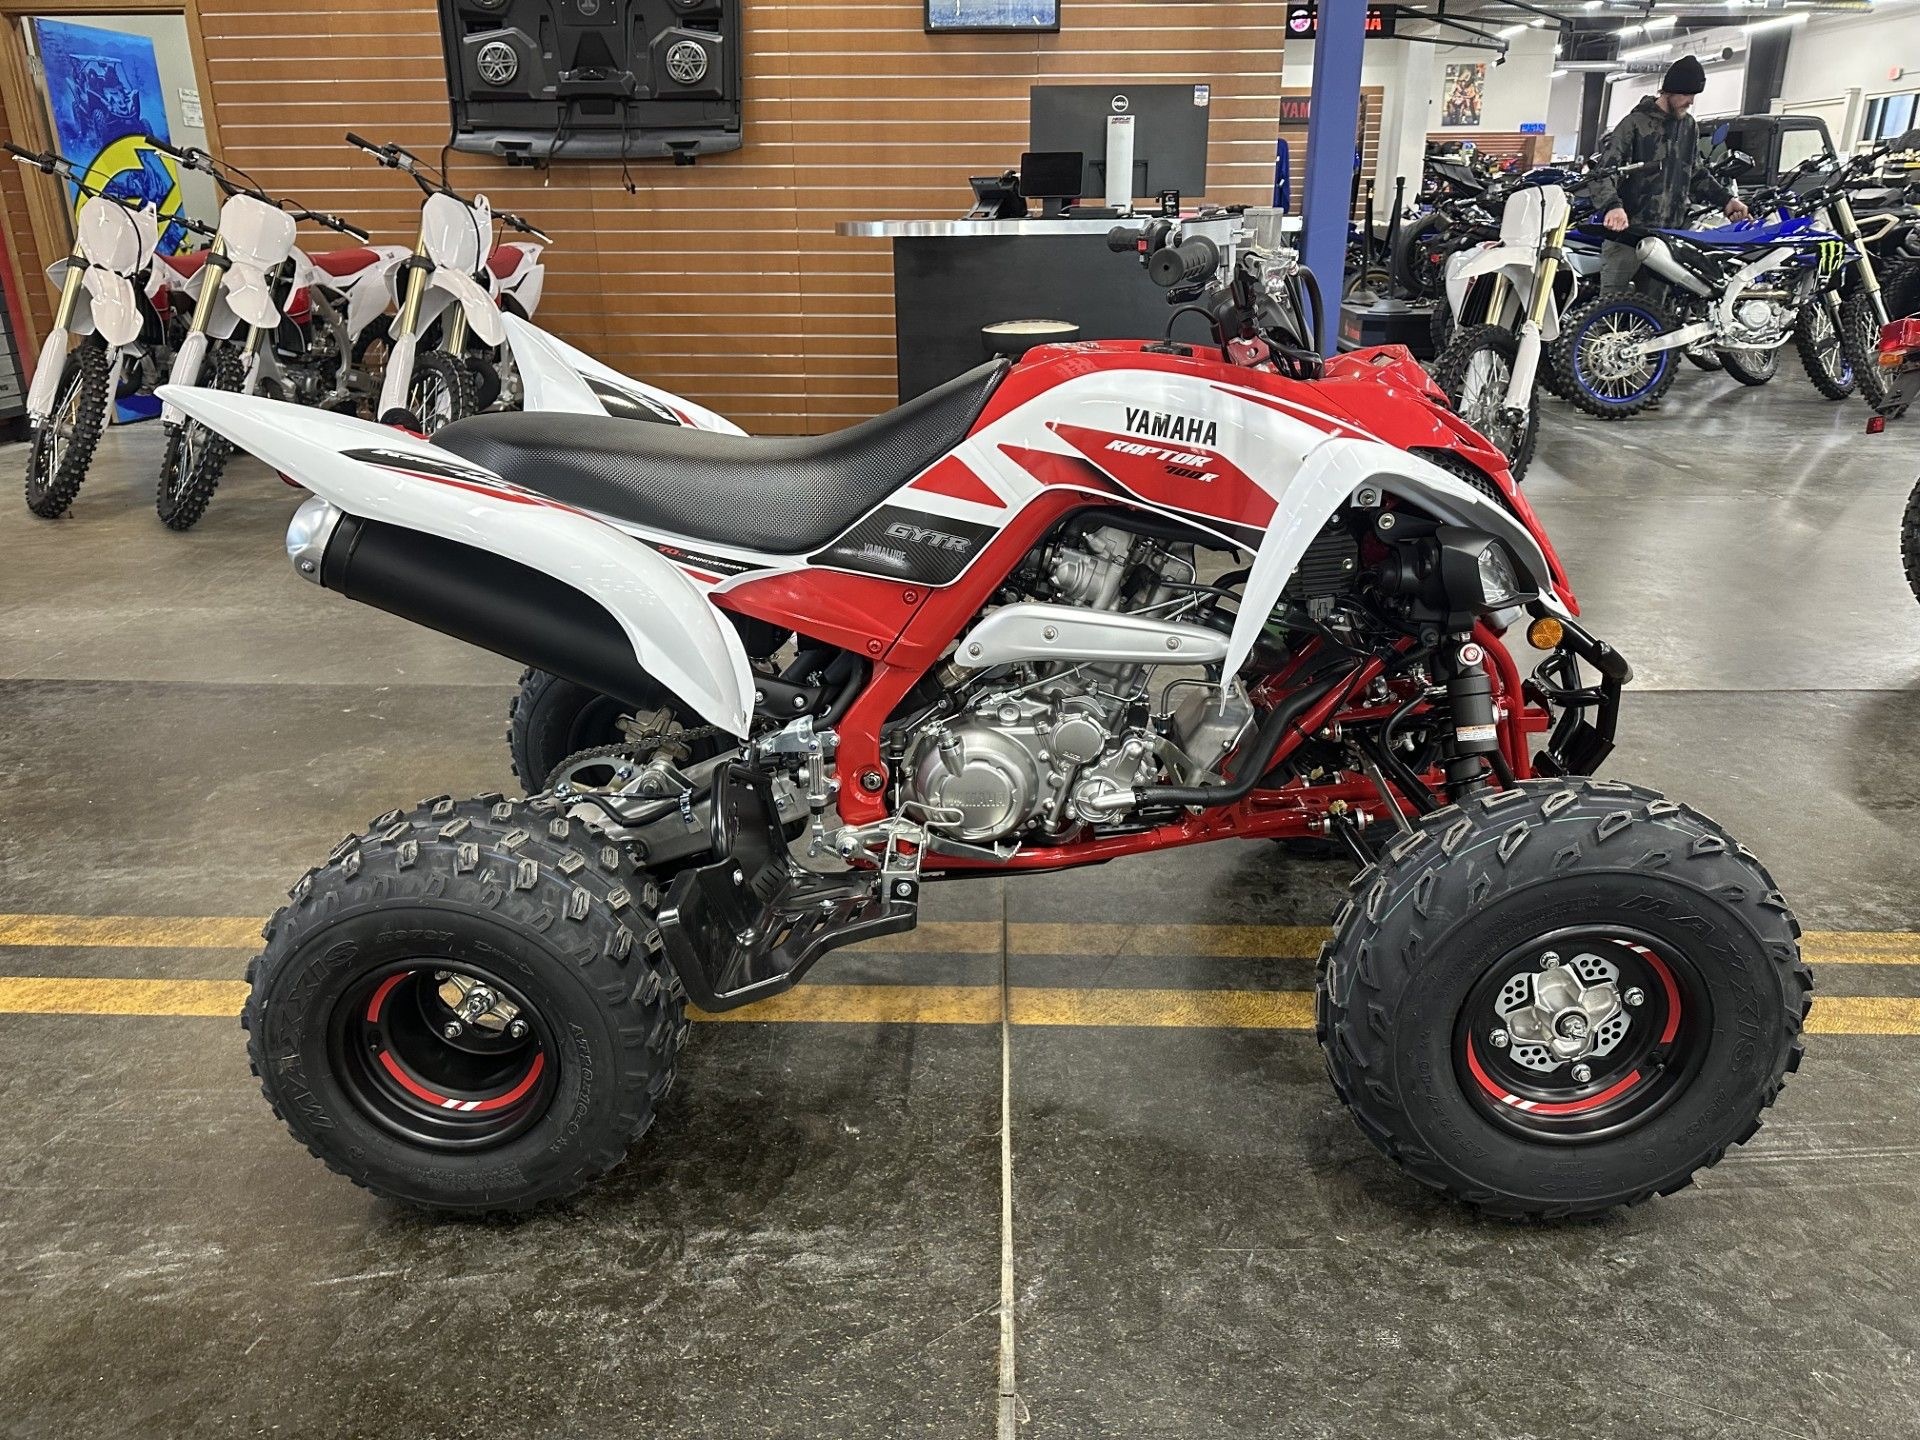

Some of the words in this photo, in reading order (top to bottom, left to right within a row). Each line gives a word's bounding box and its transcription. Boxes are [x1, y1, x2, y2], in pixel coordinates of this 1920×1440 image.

[1281, 102, 1312, 119] YAM
[1125, 406, 1218, 447] YAMAHA
[1104, 439, 1214, 468] RAPTOR
[1163, 465, 1220, 483] 700R
[884, 522, 972, 554] GYTR
